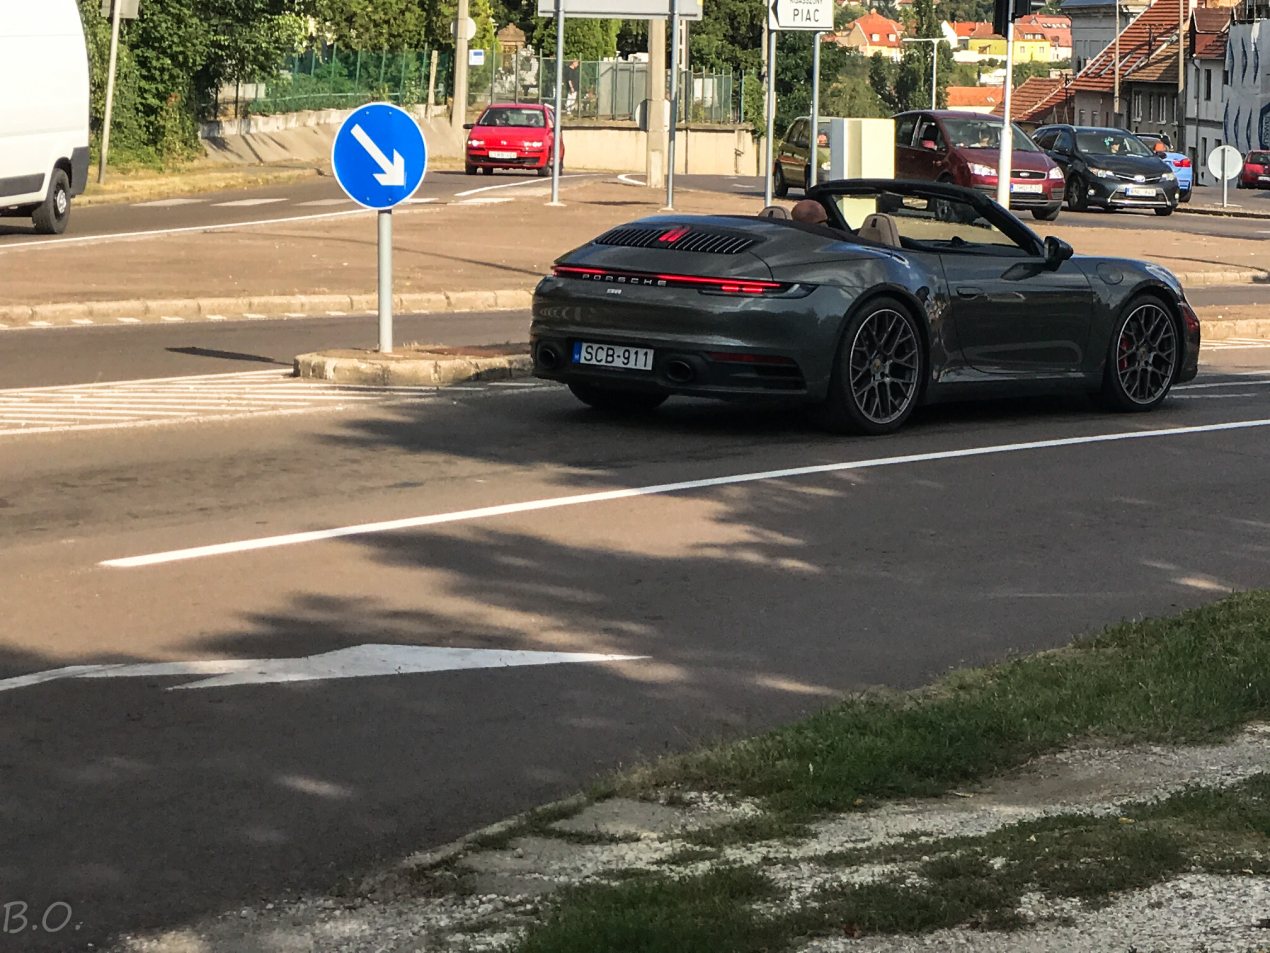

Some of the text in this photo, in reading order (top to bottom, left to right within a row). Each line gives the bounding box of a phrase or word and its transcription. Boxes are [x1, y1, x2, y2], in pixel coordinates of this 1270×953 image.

[792, 8, 820, 23] PIAC
[582, 273, 667, 286] PORSCHE
[583, 344, 649, 369] SCB-911
